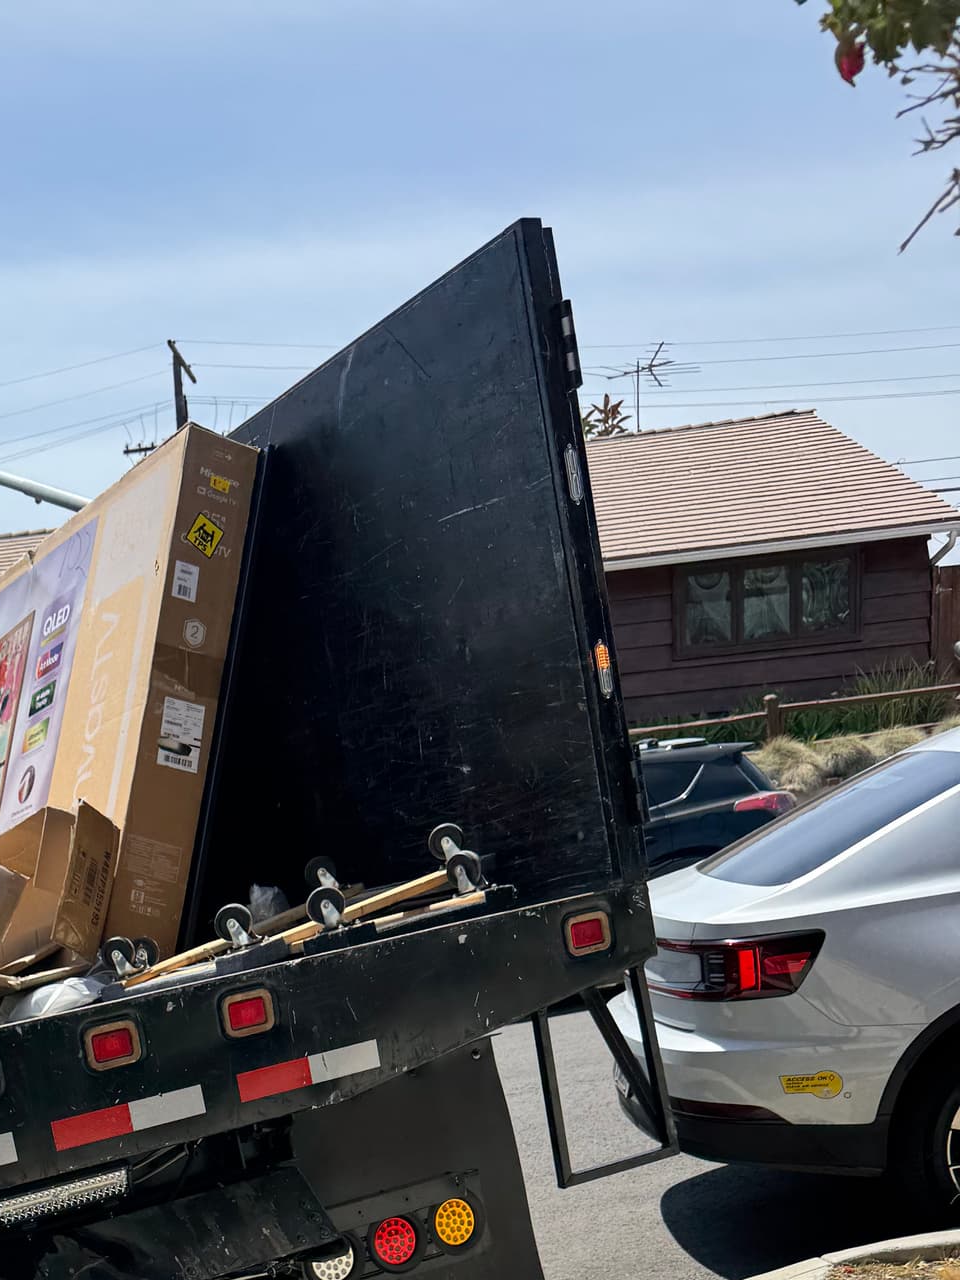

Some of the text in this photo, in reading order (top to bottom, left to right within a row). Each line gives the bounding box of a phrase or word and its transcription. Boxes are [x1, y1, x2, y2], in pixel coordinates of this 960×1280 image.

[193, 536, 207, 552] TPS
[43, 604, 70, 637] QLED
[190, 625, 199, 639] 2
